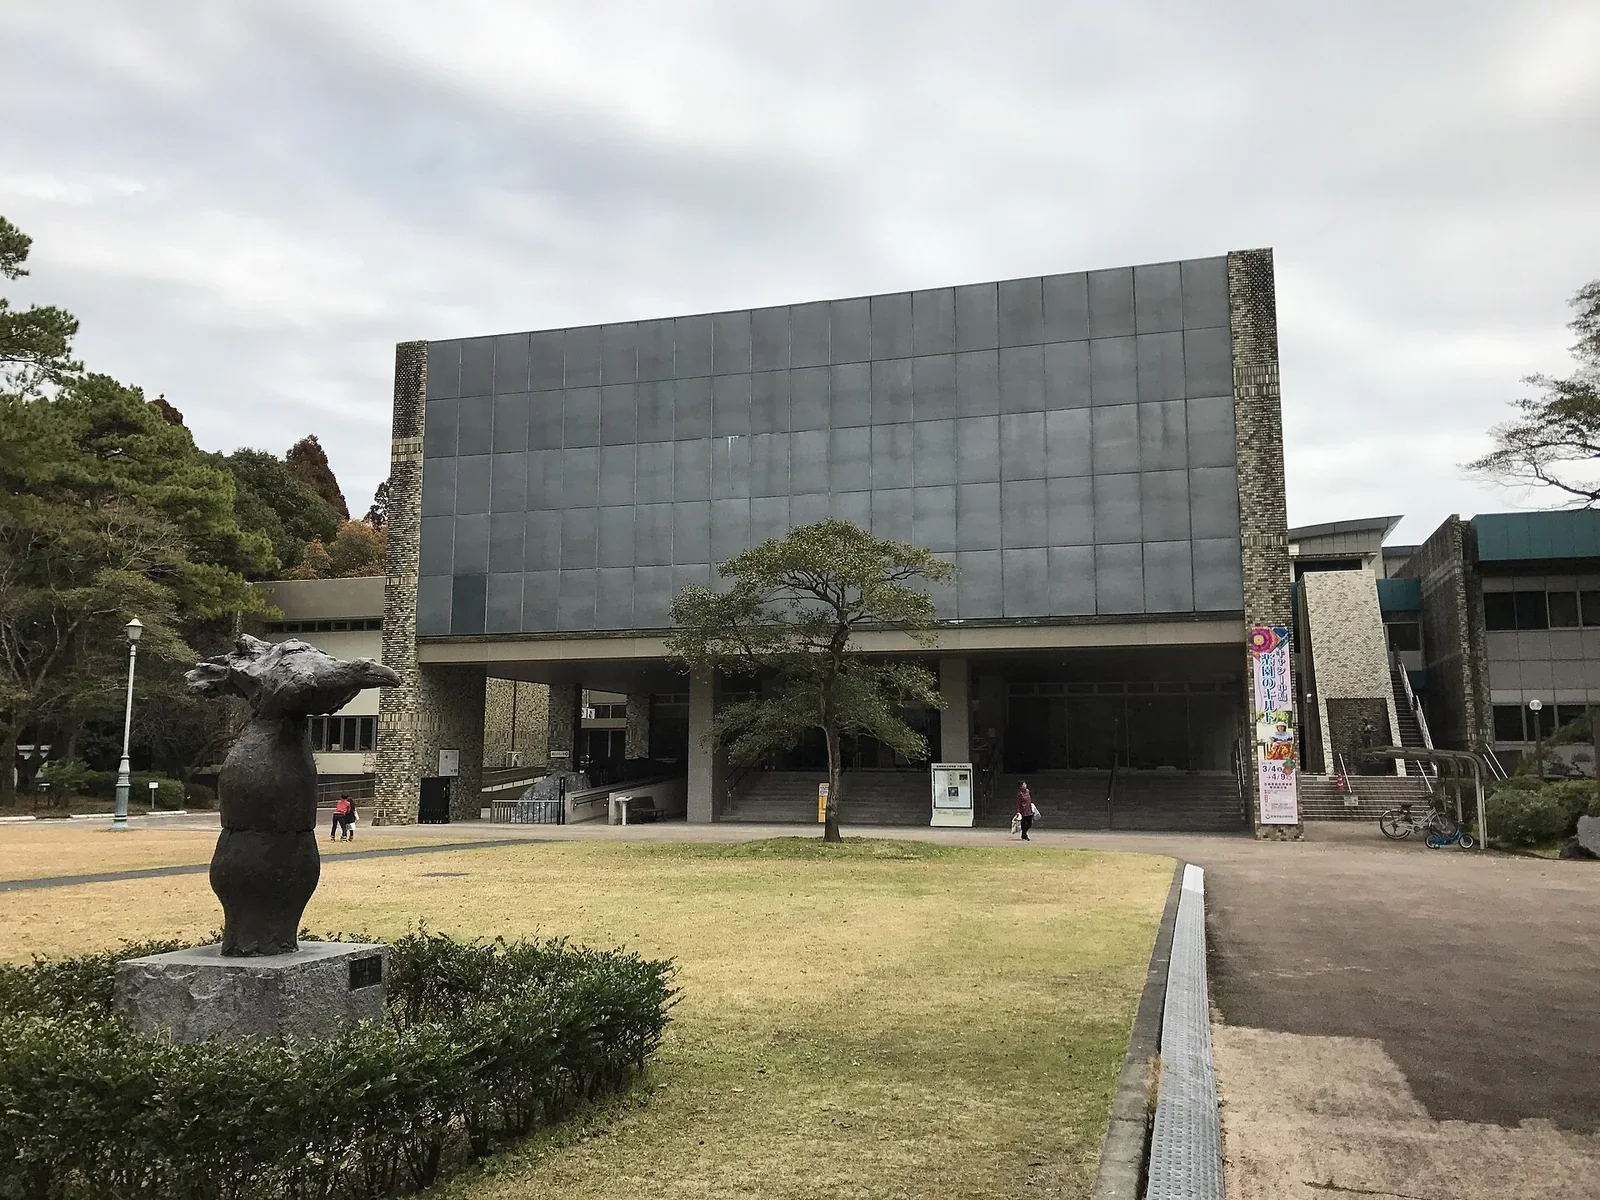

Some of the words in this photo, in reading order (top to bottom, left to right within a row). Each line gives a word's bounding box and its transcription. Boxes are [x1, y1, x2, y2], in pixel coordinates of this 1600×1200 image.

[1261, 653, 1277, 724] 楽園のキルト
[1262, 765, 1276, 773] 3/4
[1271, 773, 1286, 781] 4/9
